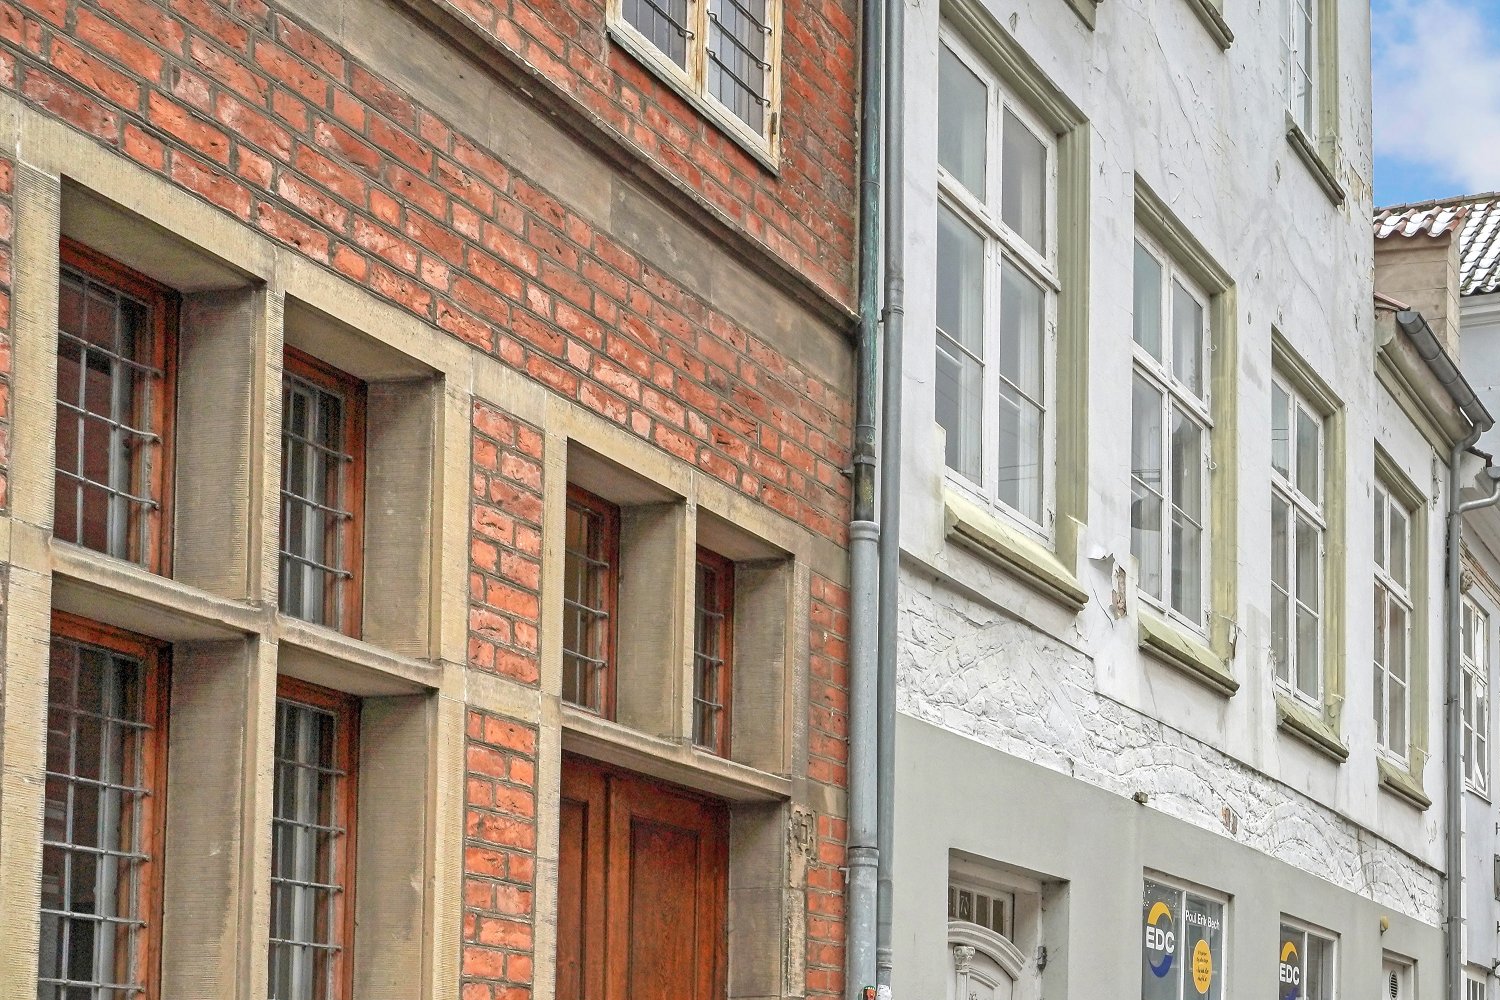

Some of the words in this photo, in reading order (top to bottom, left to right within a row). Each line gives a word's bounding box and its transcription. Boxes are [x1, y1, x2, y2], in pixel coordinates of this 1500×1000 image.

[1186, 910, 1197, 924] Poul
[1146, 926, 1175, 953] EDC
[1280, 963, 1300, 985] EDC
